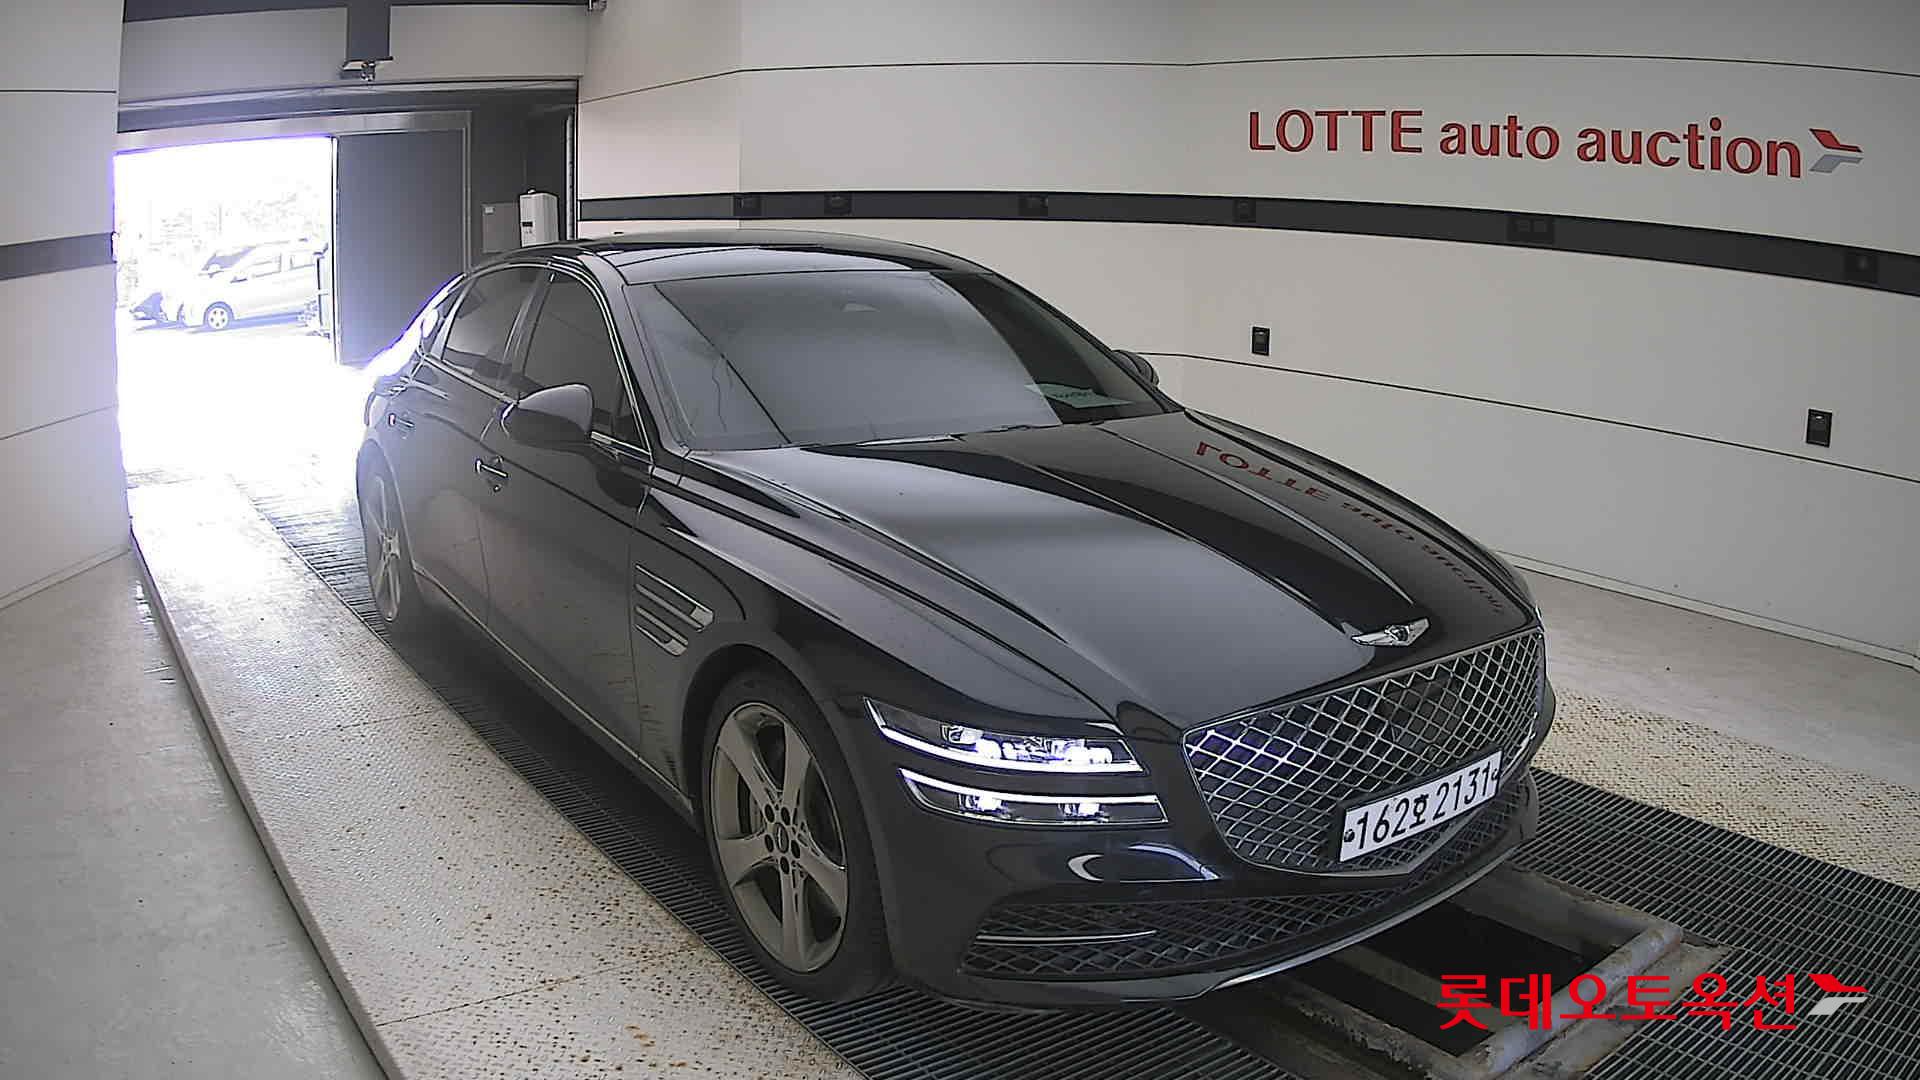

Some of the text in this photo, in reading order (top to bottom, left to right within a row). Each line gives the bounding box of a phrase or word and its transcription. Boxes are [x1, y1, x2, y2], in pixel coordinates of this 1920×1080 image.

[1249, 110, 1802, 178] LOTTE auto auction
